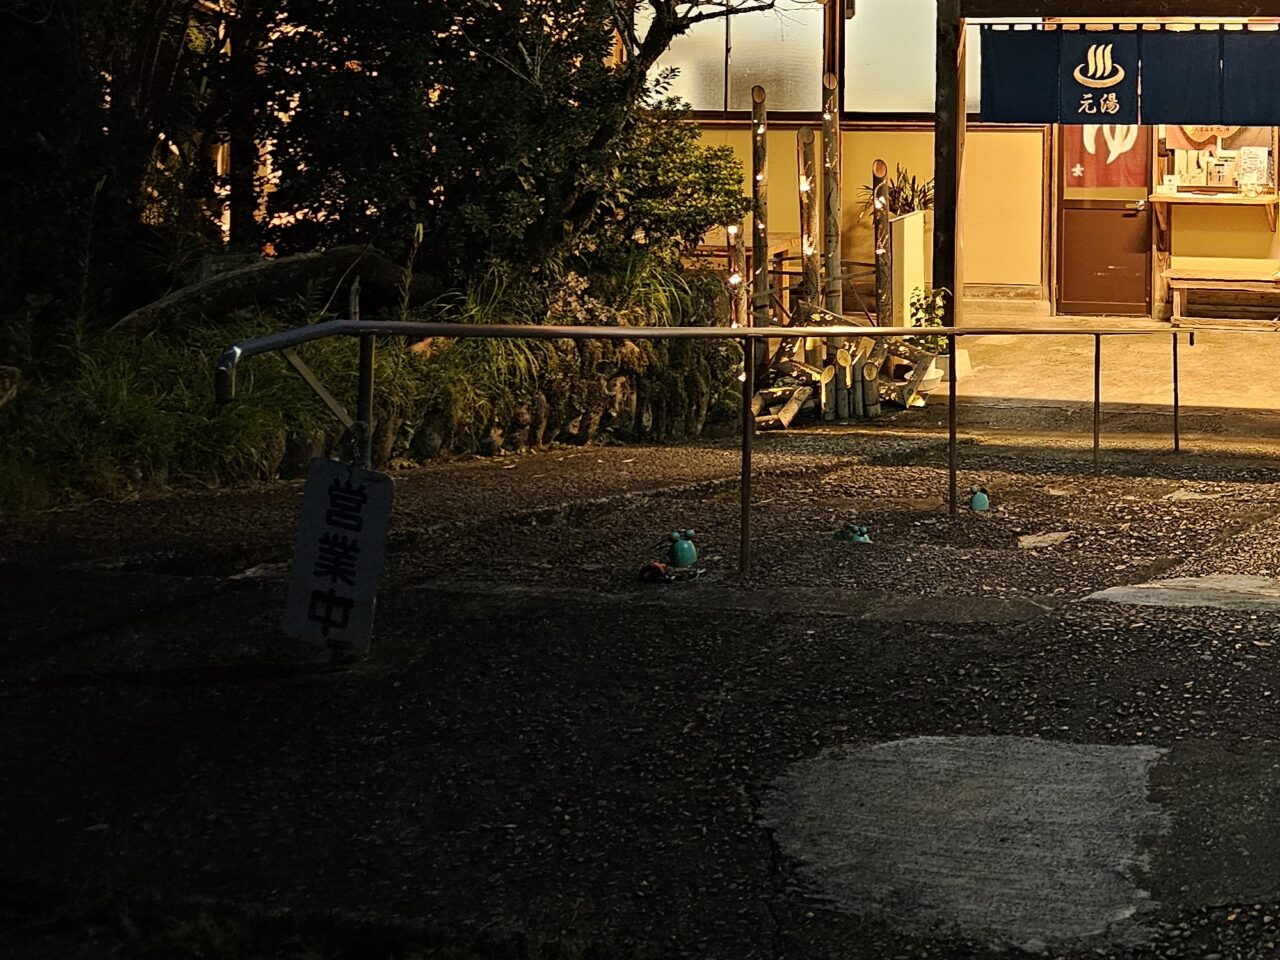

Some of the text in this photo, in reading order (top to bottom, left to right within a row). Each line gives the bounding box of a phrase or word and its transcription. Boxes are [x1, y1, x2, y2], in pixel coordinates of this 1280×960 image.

[1078, 93, 1120, 114] 元湯
[1071, 163, 1085, 177] 女
[307, 477, 368, 637] 営業中
